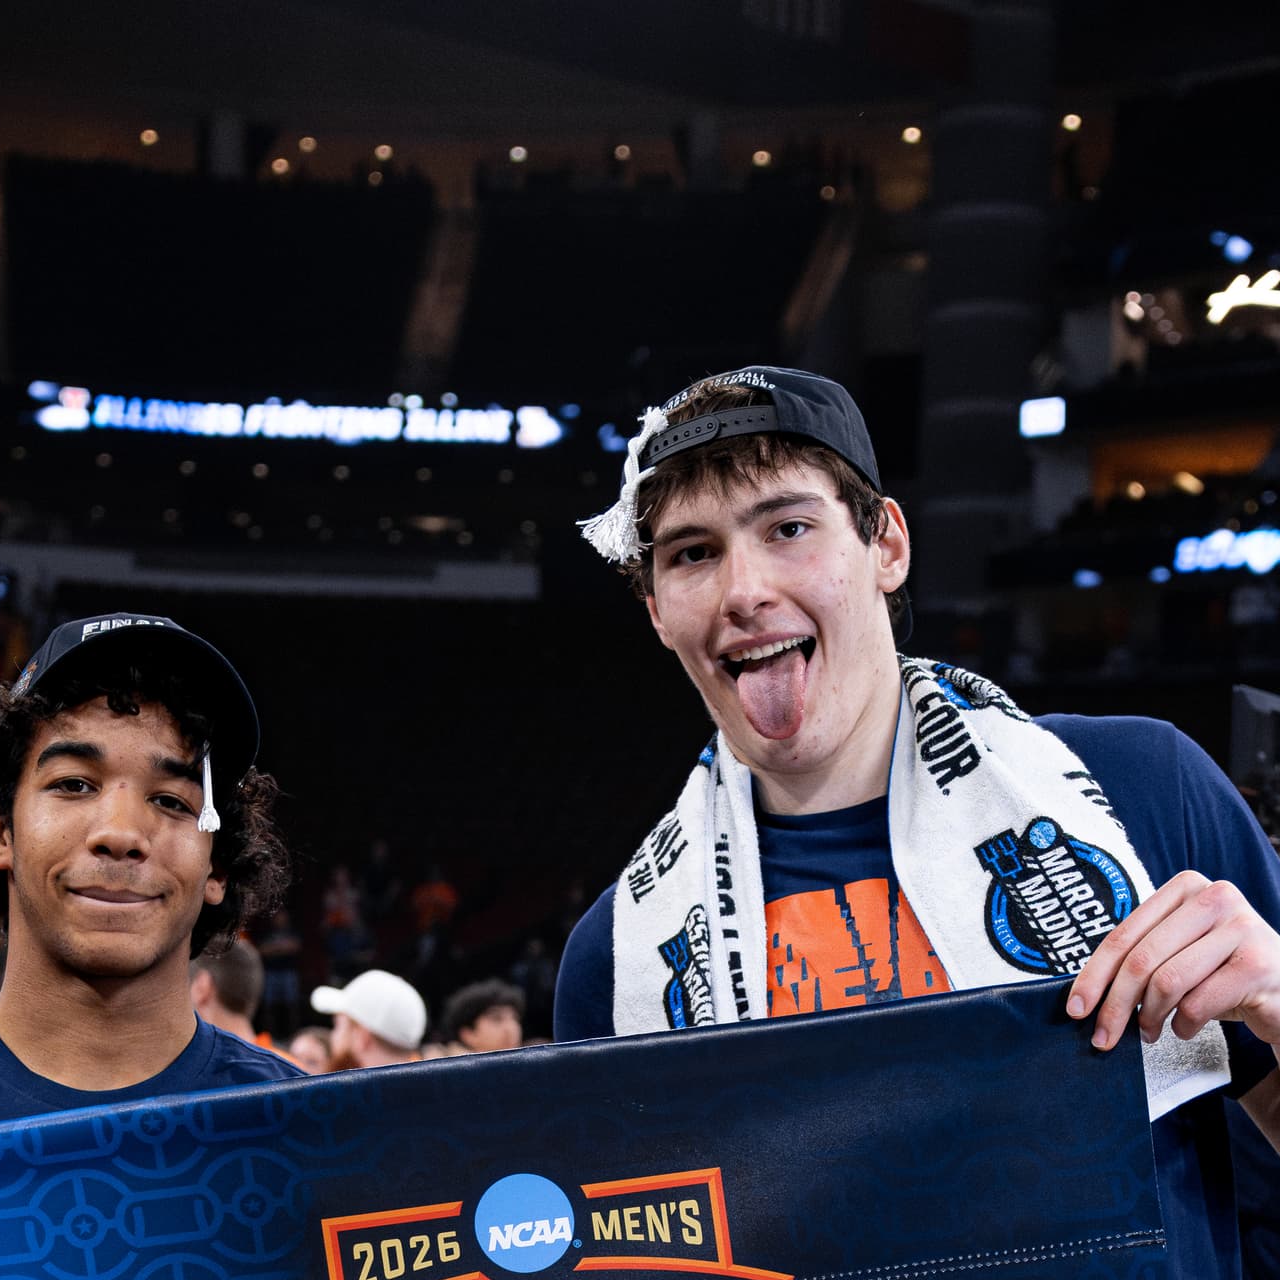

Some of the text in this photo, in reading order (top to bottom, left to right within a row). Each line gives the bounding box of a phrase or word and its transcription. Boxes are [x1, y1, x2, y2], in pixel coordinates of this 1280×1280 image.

[1036, 845, 1116, 938] MARCH
[1091, 853, 1127, 900] SWEET 16
[993, 917, 1016, 947] ELITE
[1016, 874, 1087, 976] MADNES
[487, 1216, 573, 1252] NCAA
[592, 1199, 703, 1245] MEN'S
